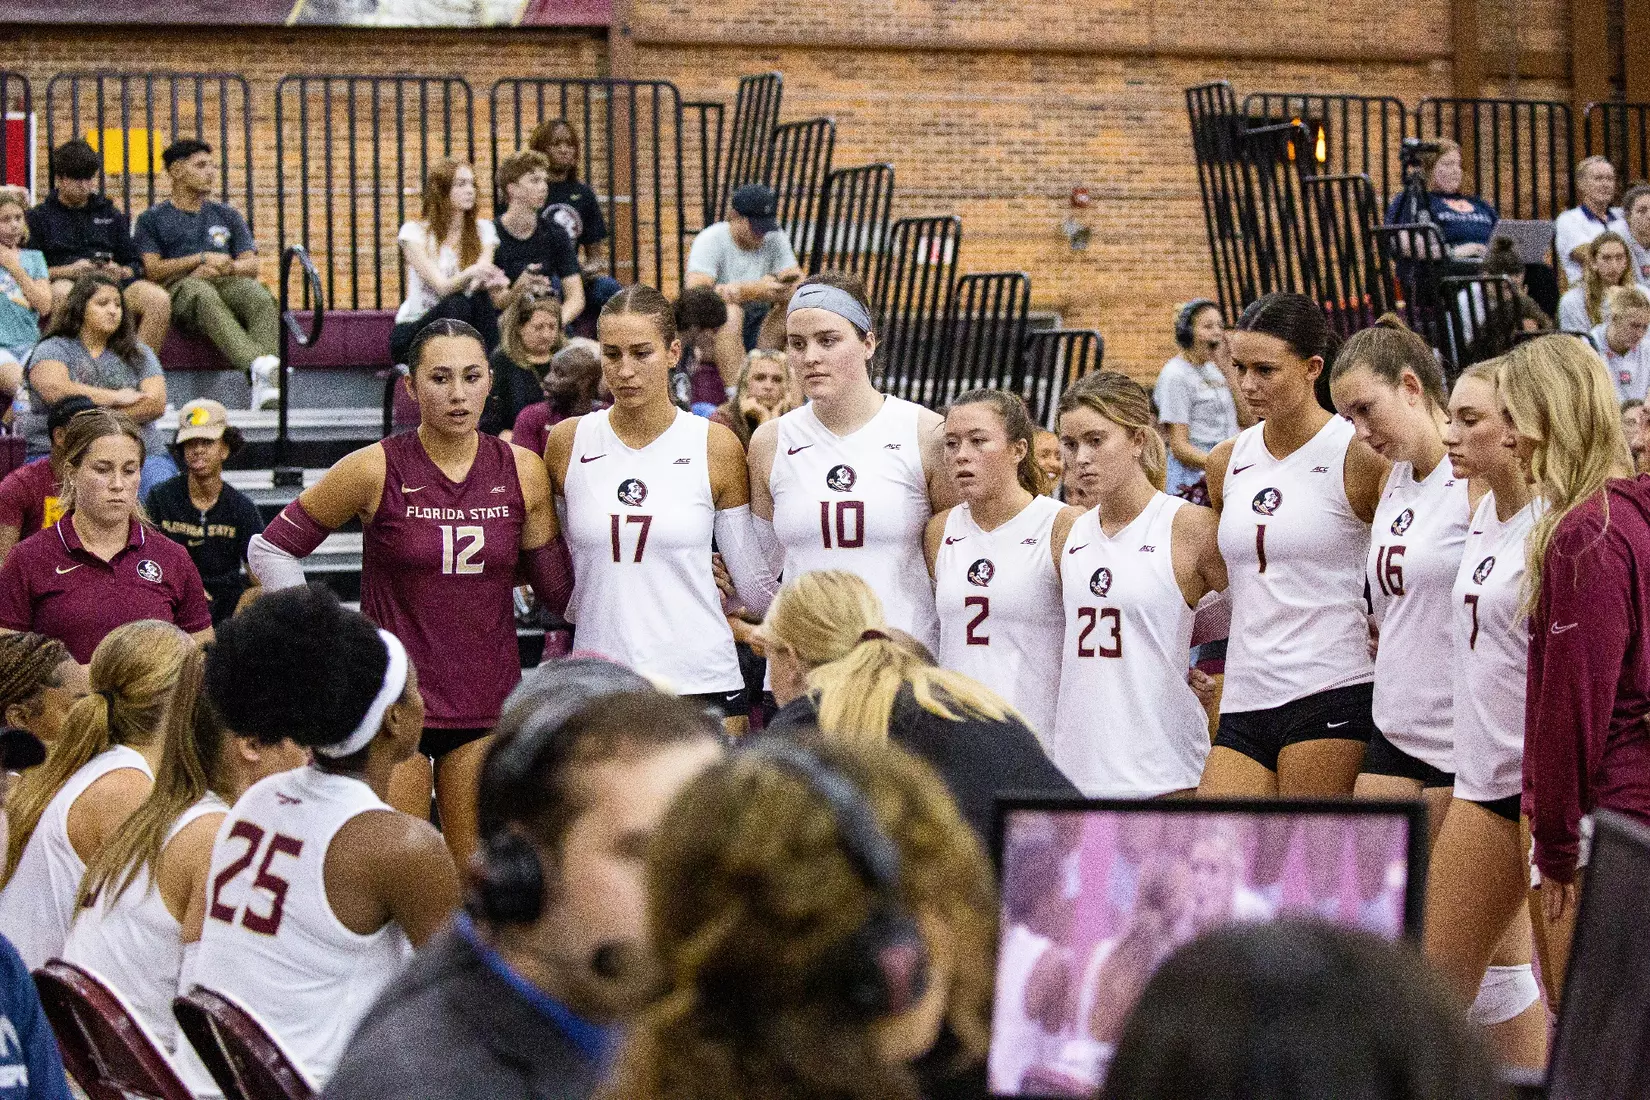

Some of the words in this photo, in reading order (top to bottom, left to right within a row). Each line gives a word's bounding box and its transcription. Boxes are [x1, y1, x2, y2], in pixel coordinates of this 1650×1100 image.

[406, 506, 465, 520] FLORIDA
[469, 506, 510, 520] STATE
[819, 500, 864, 549] 10
[439, 525, 485, 574] 12
[609, 514, 653, 563] 17
[1255, 524, 1267, 574] 1
[1376, 545, 1406, 597] 16
[964, 596, 989, 646] 2
[1078, 606, 1122, 658] 23
[1464, 594, 1479, 651] 7
[210, 820, 304, 936] 25
